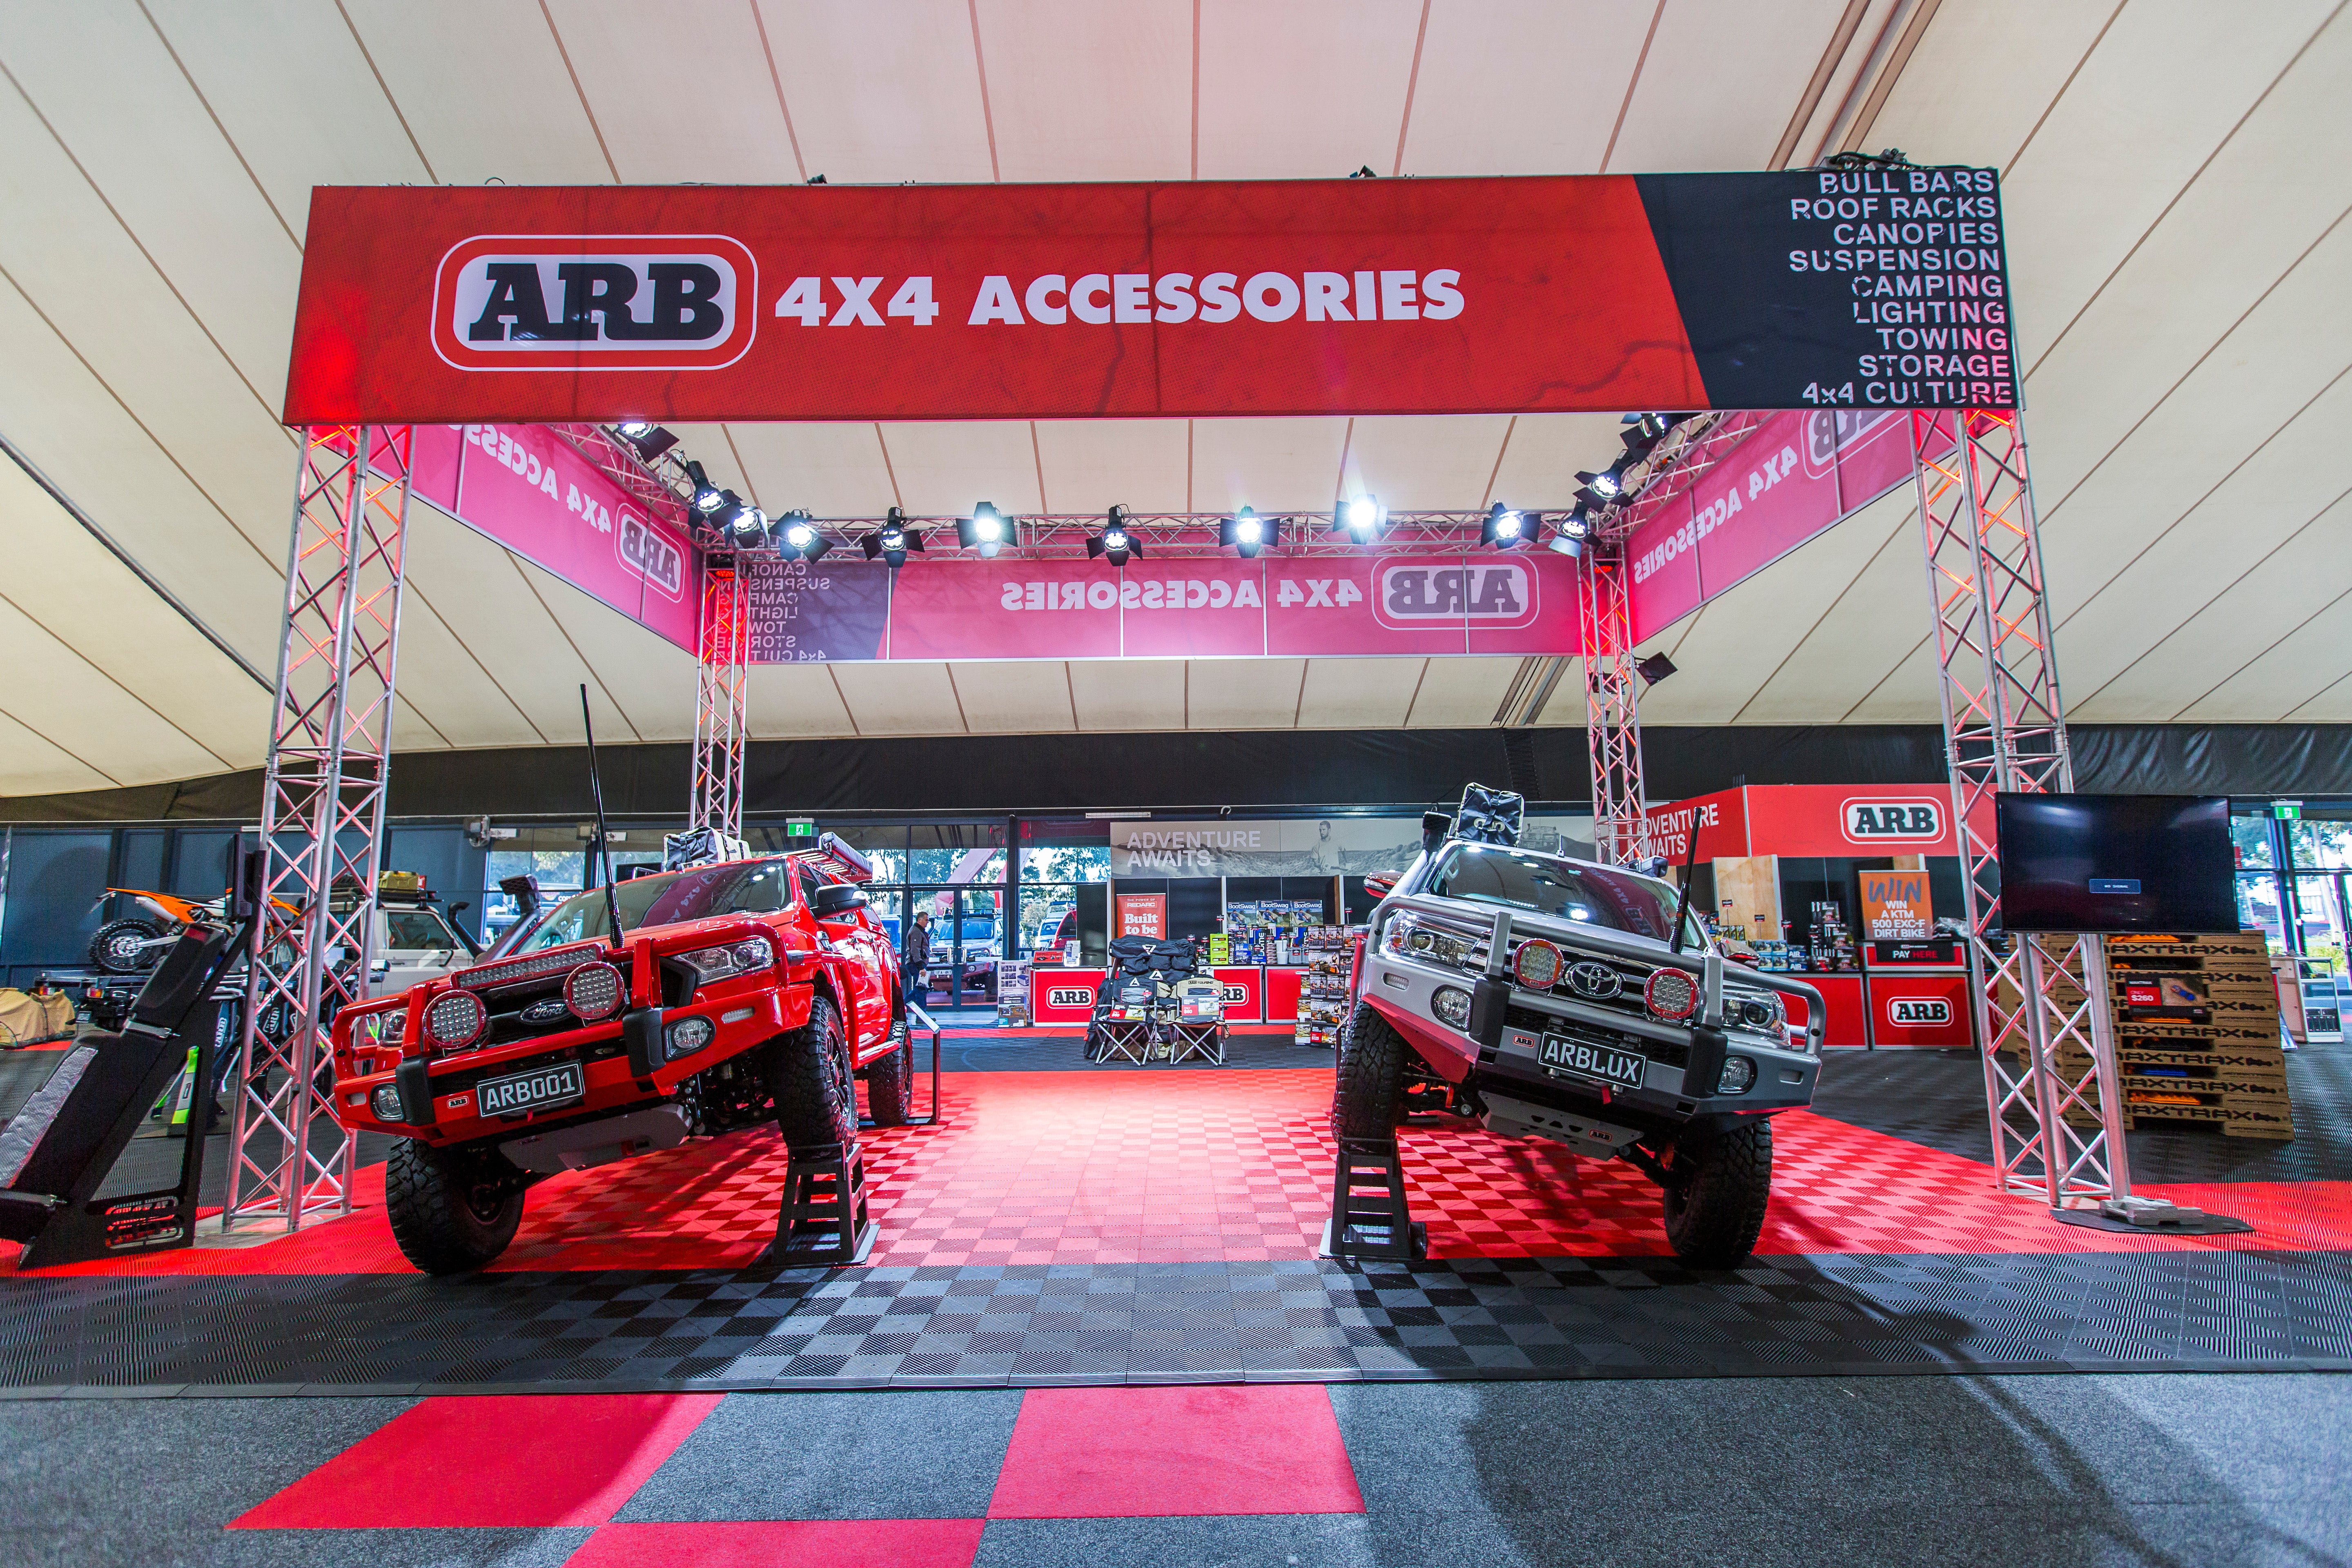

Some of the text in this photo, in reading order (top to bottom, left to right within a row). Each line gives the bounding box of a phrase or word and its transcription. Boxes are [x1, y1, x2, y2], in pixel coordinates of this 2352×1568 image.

[1820, 171, 1994, 194] BULL BARS
[1791, 196, 1996, 220] ROOF RACKS
[1833, 223, 1998, 245] CANOPIES
[1789, 249, 2000, 272] SUSPENSION
[1852, 275, 2002, 297] CAMPING
[468, 263, 1465, 341] ARB 4X4 ACCESSORIES
[1853, 301, 2005, 323] LIGHTING
[1875, 328, 2008, 350] TOWING
[1859, 354, 2009, 377] STORAGE
[1802, 382, 2012, 404] 4x4 CULTURE
[1855, 807, 1935, 833] ARB
[1127, 830, 1261, 849] ADVENTURE
[1127, 849, 1211, 868] AWAITS
[1868, 877, 1922, 903] WIN
[1881, 909, 1914, 918] A KTM
[1885, 900, 1907, 909] WIN
[1125, 913, 1158, 924] Built
[1125, 924, 1158, 935] to be
[1871, 919, 1925, 928] 500 EXC-F
[1874, 929, 1925, 938] DIRT BIKE
[1892, 950, 1938, 958] PAY HERE
[1052, 991, 1089, 1004] ARB
[1897, 1003, 1948, 1020] ARB
[1544, 1040, 1639, 1082] ARBLUX
